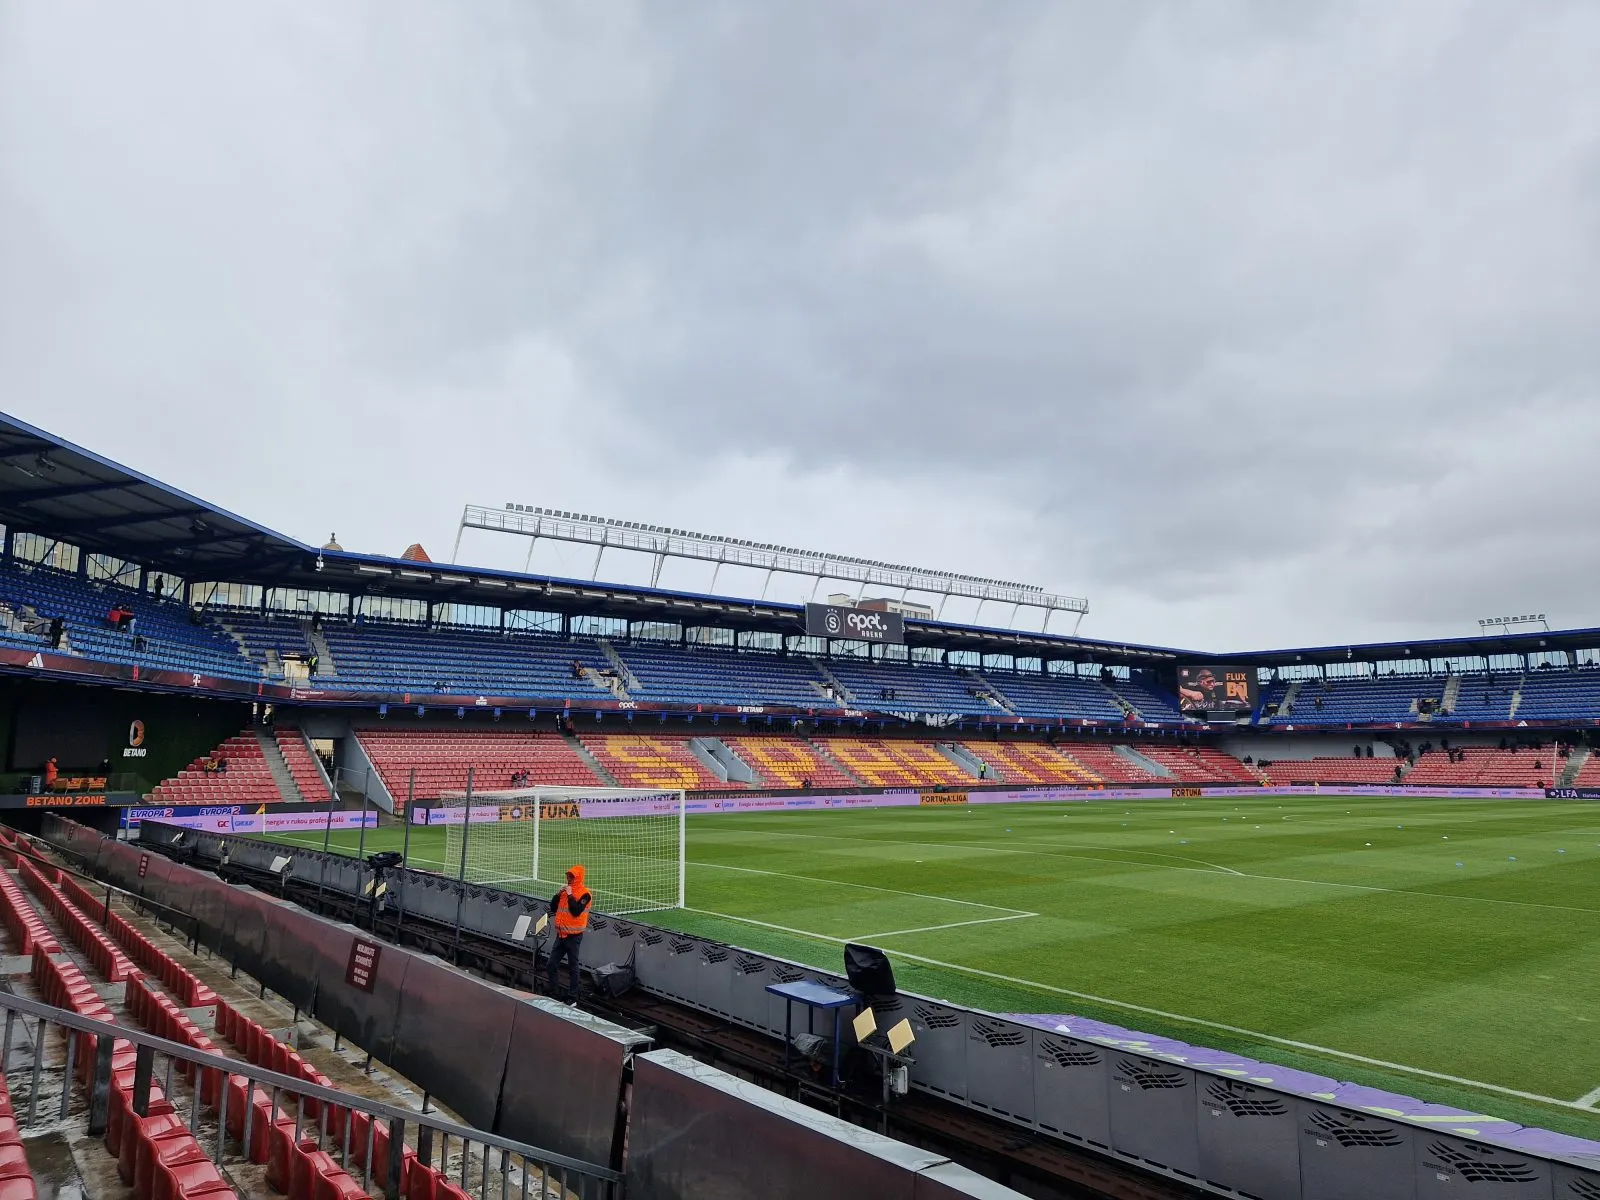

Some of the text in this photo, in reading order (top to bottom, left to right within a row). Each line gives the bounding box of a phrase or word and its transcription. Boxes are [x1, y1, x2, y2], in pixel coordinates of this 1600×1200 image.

[847, 613, 888, 631] epet.
[861, 630, 883, 639] ARENA
[1226, 672, 1247, 681] FLUX
[123, 748, 147, 757] BETANO
[1171, 788, 1202, 798] FORTUNA
[26, 795, 106, 806] BETANO ZONE
[217, 820, 230, 828] GC
[208, 1009, 215, 1018] 2
